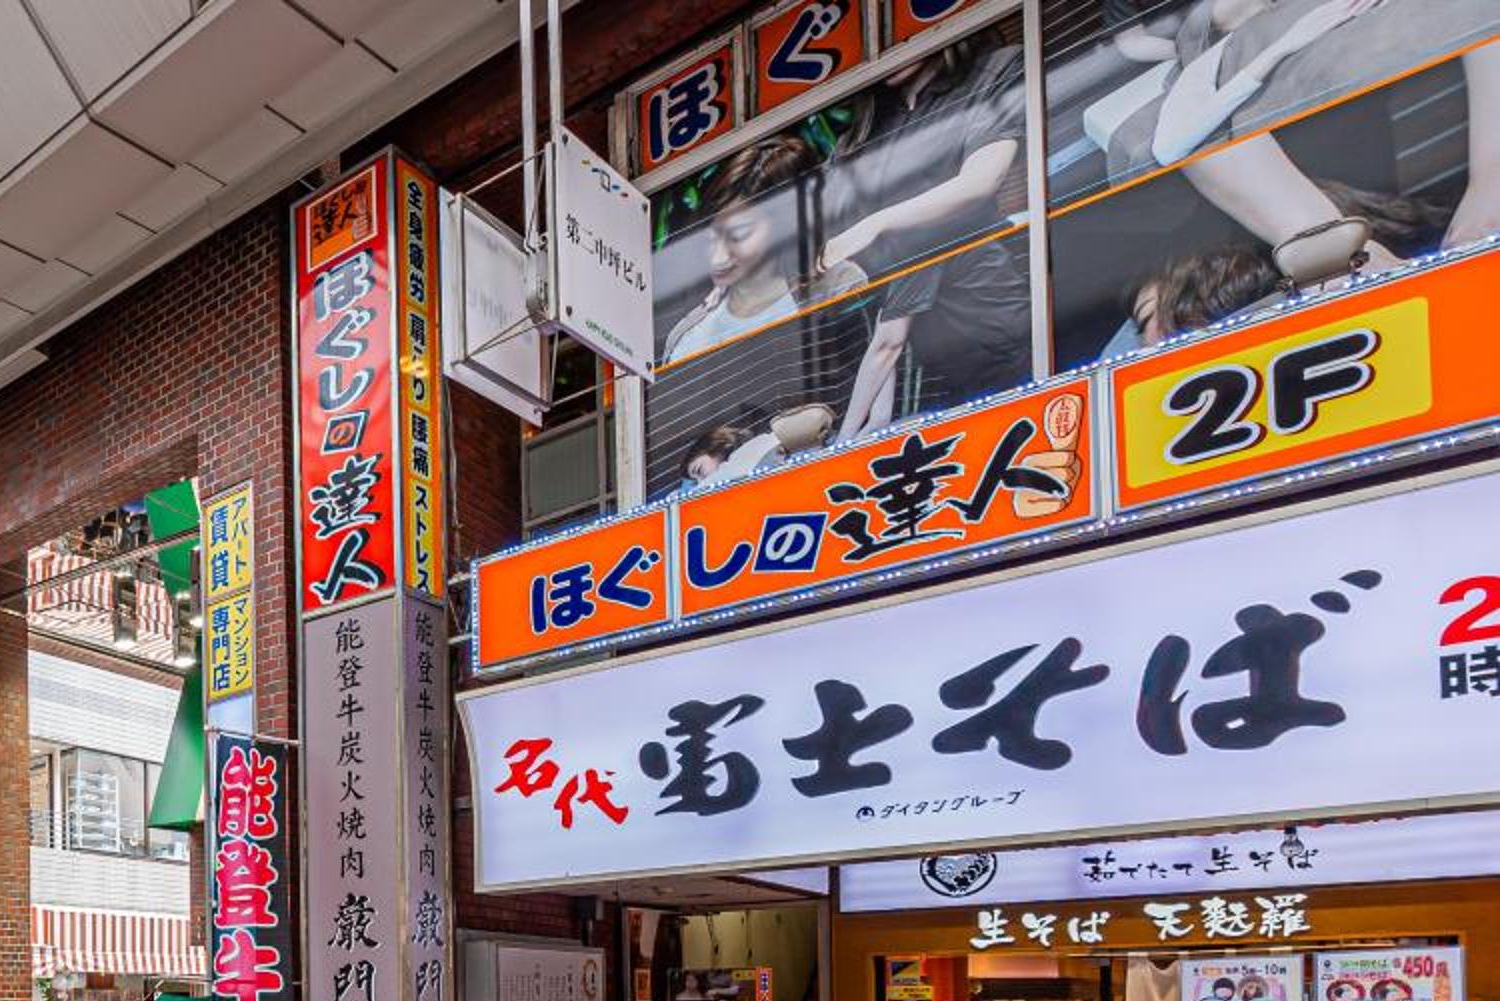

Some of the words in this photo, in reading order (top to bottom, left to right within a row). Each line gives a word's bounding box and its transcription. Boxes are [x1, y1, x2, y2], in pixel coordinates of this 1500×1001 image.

[309, 248, 387, 605] ほぐしの達人
[1163, 327, 1385, 467] 2F
[414, 486, 429, 592] ストレス
[528, 418, 1071, 634] ほぐしの達人
[495, 737, 629, 830] 名代
[880, 788, 1026, 819] ダイタングループ
[970, 910, 1112, 950] 生そば
